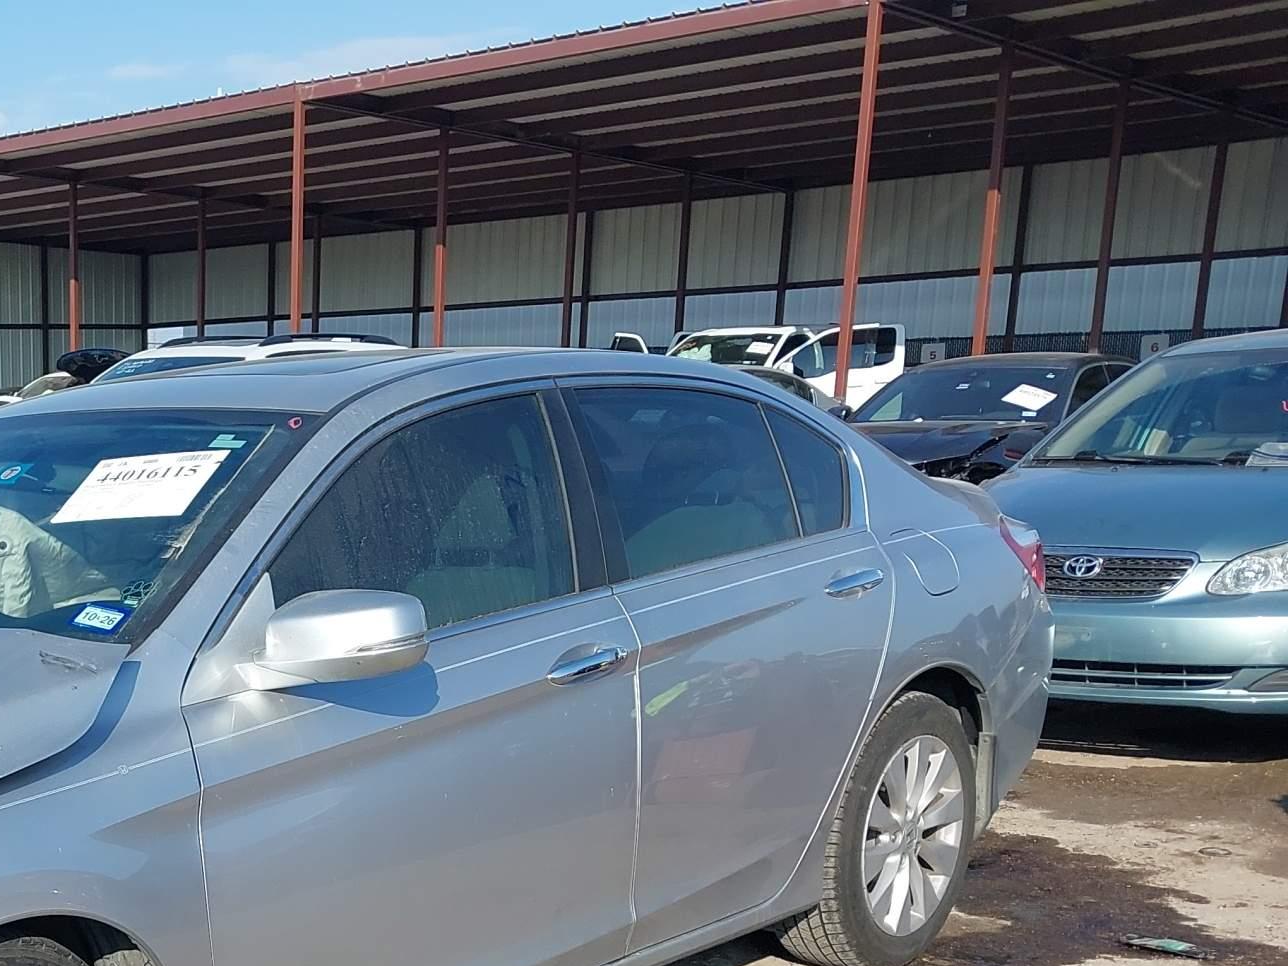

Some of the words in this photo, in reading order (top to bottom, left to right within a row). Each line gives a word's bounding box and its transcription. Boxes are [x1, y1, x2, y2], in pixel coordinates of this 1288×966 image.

[1151, 342, 1160, 353] 6
[929, 350, 937, 360] 5
[96, 464, 202, 483] 44016115
